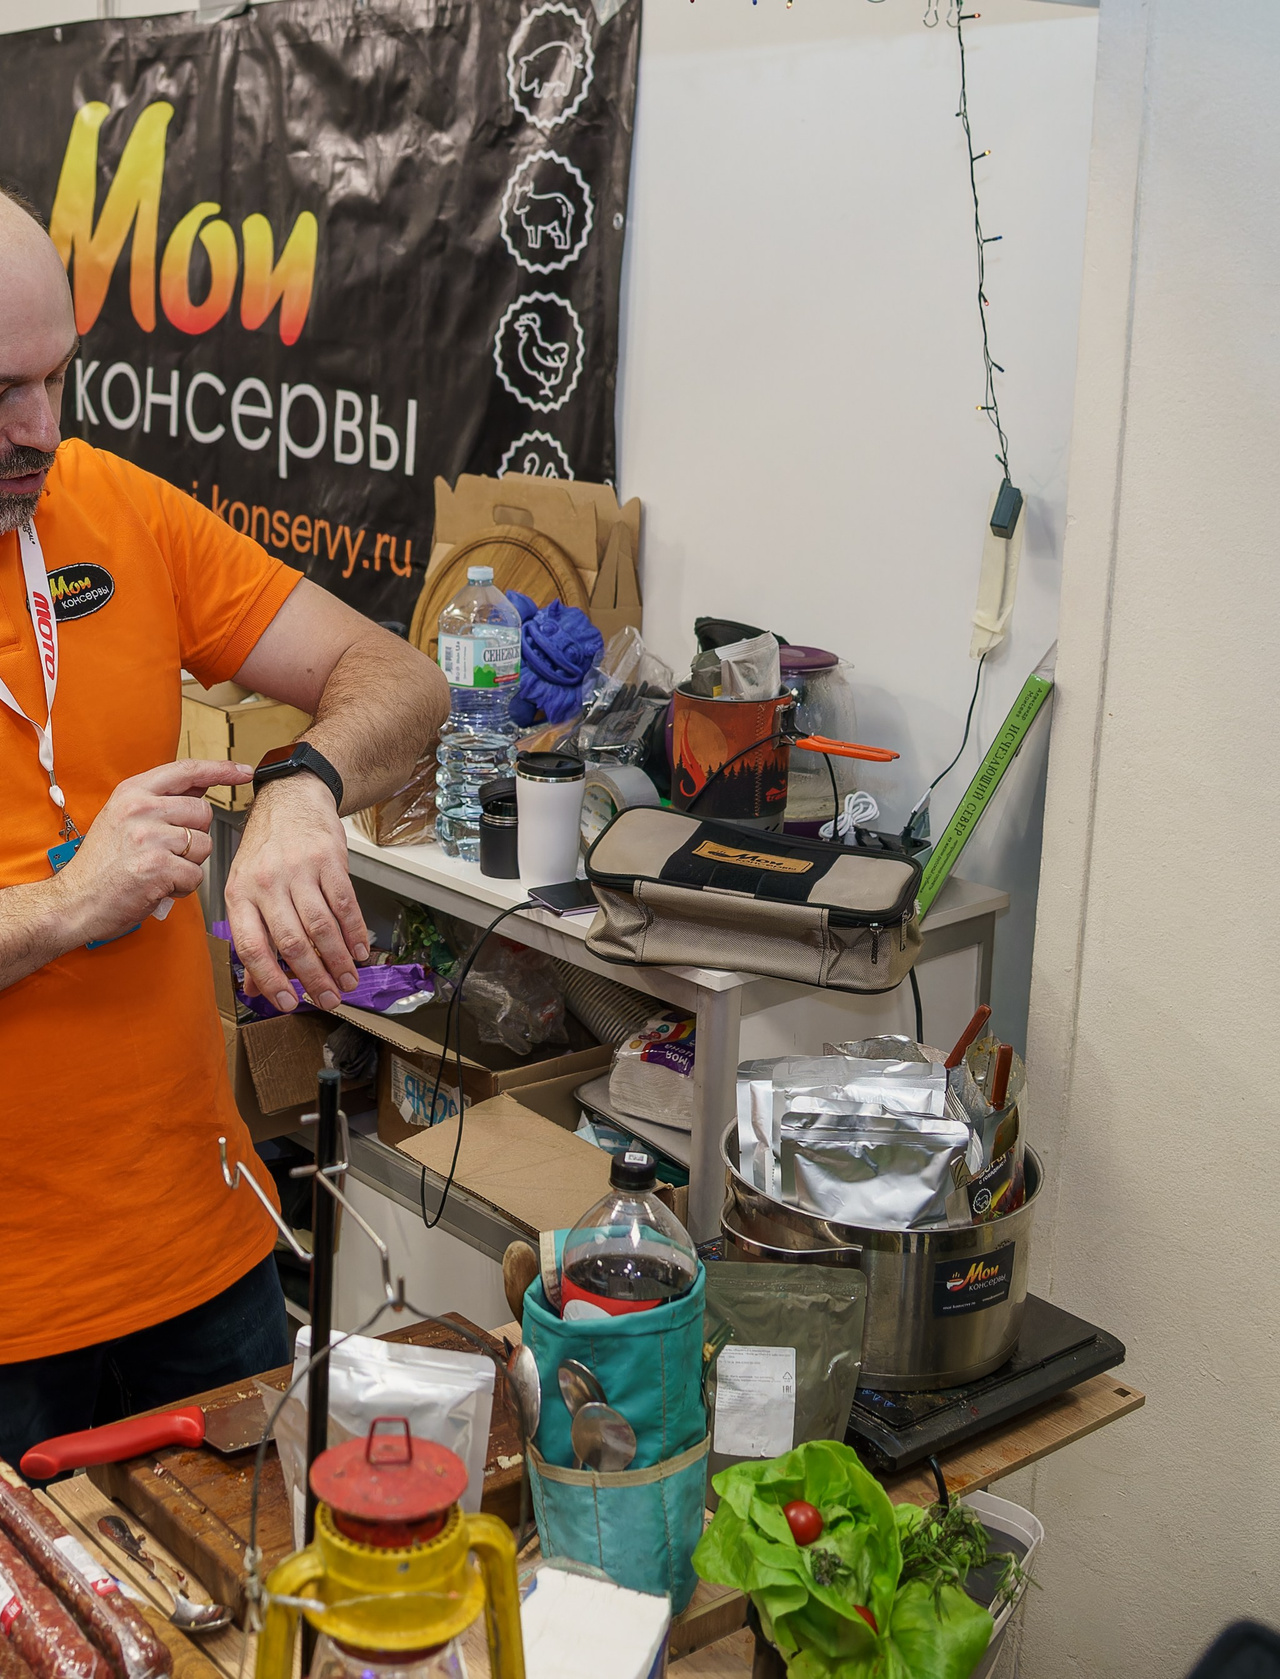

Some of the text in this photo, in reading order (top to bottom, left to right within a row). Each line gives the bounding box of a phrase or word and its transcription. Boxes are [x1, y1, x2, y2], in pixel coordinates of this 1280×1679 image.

[48, 100, 319, 346] Мои
[75, 358, 419, 478] консервы
[32, 591, 56, 681] MOTO
[61, 585, 110, 610] консервы
[953, 723, 1021, 838] ИСЧЕЗАЮЩИЙ СЕВЕР
[965, 1261, 1000, 1284] Мои
